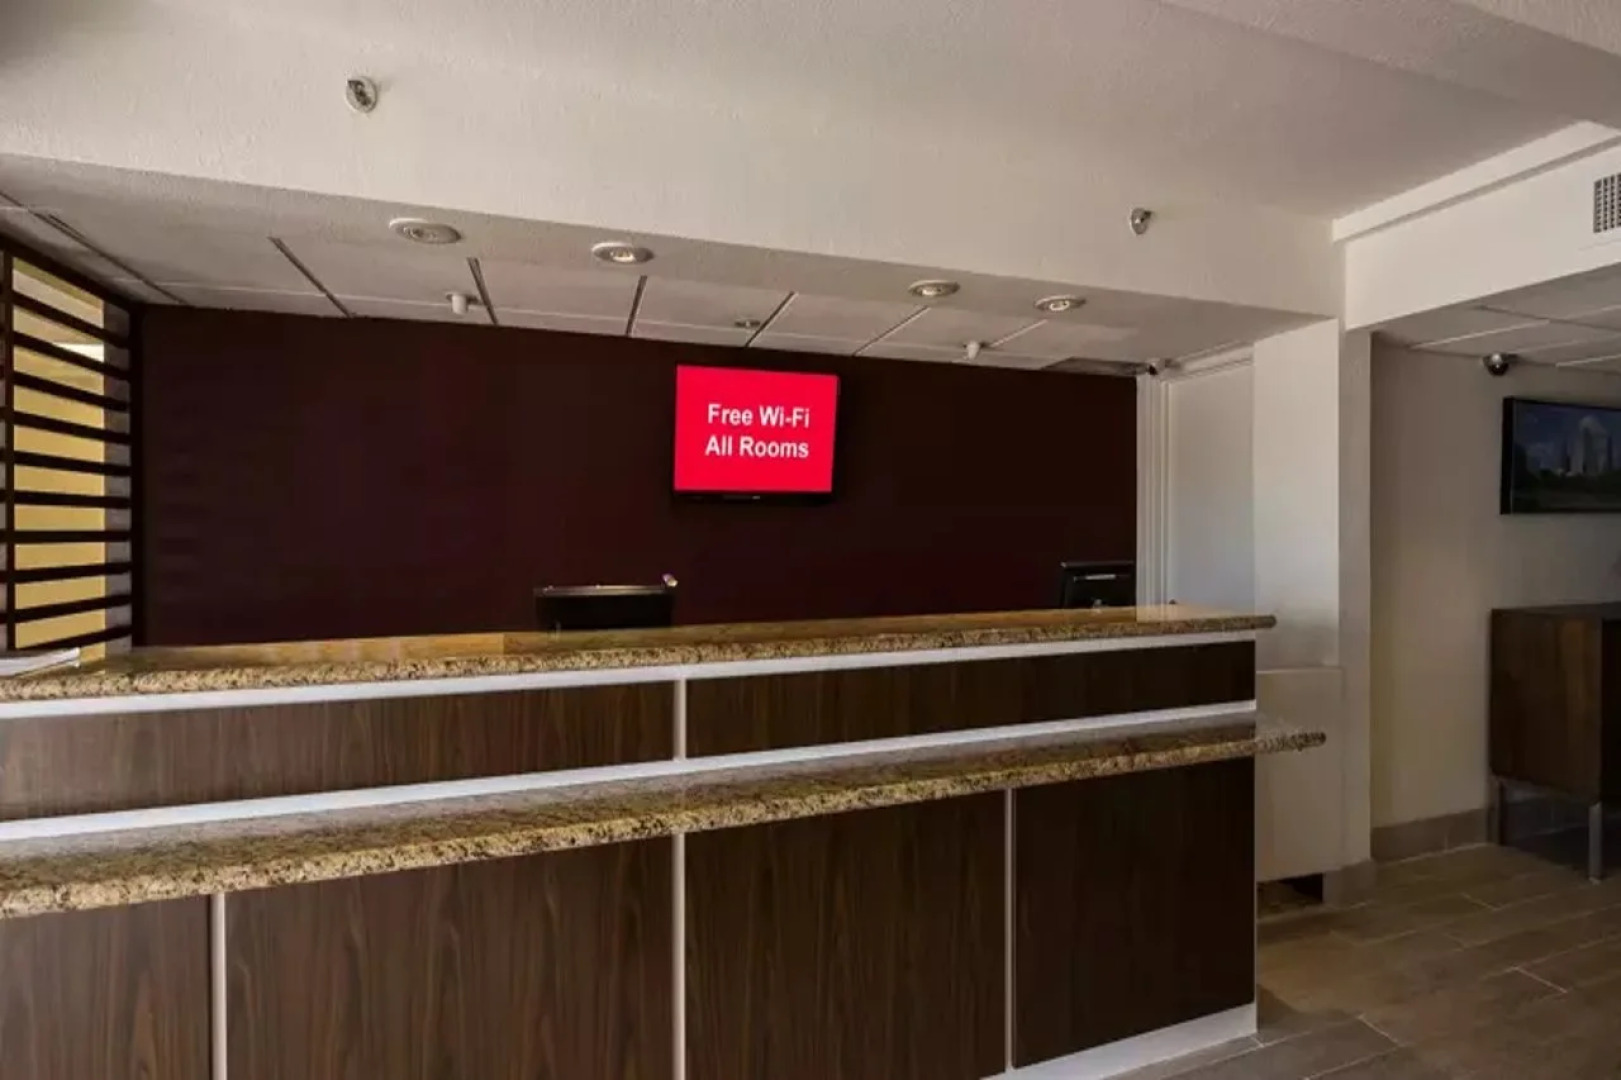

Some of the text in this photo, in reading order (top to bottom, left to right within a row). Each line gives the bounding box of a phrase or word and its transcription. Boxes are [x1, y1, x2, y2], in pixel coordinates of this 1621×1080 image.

[707, 403, 810, 428] Free Wi-Fi
[705, 435, 809, 458] All Rooms
